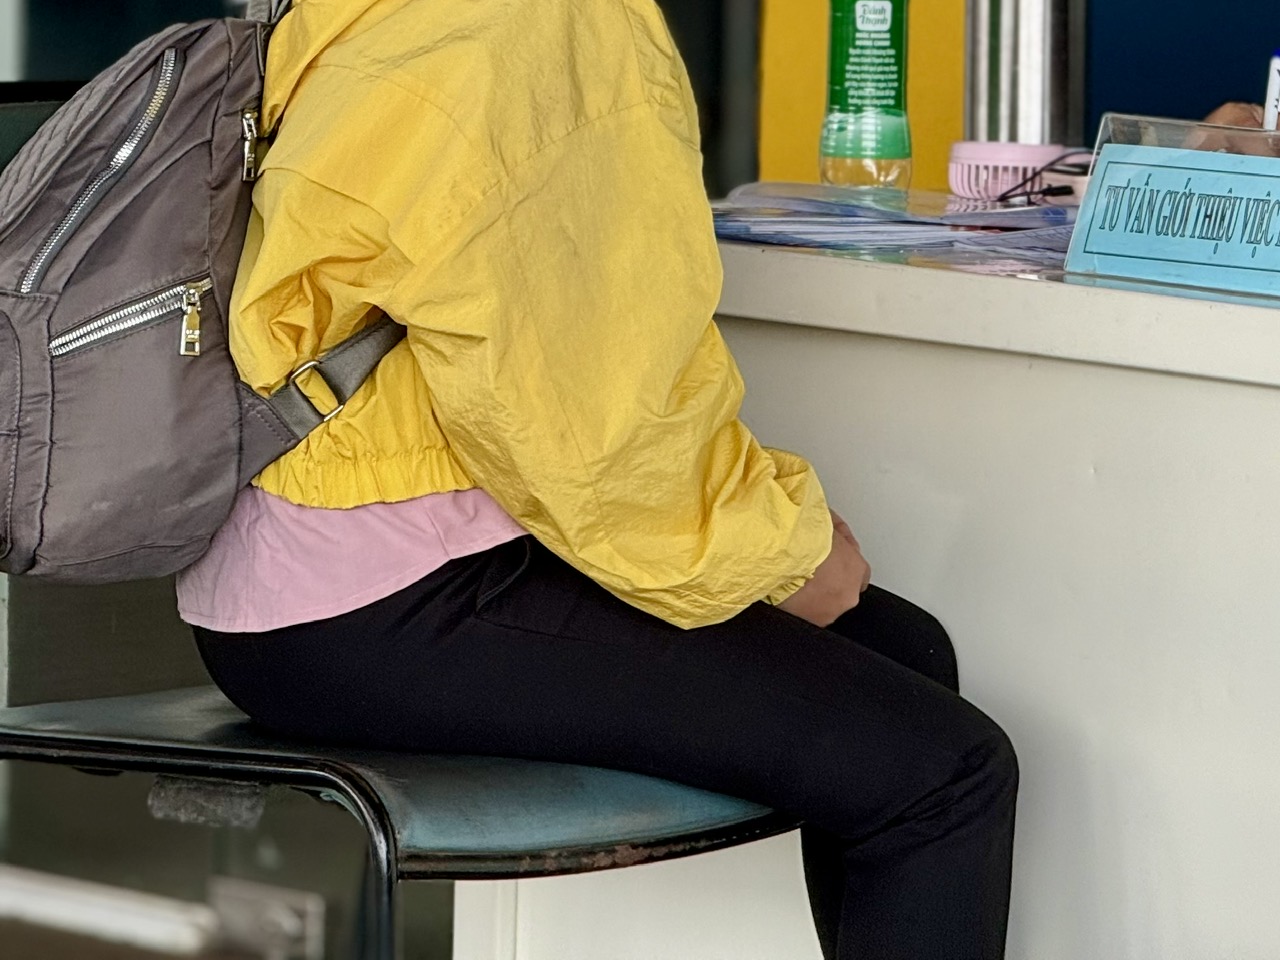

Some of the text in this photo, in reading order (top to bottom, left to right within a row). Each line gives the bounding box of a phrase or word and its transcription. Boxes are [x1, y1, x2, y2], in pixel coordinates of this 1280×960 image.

[1099, 178, 1131, 231] TƯ
[1122, 173, 1161, 235] VẤN
[1155, 177, 1195, 238] GIỚI
[1189, 187, 1244, 255] THIỆU
